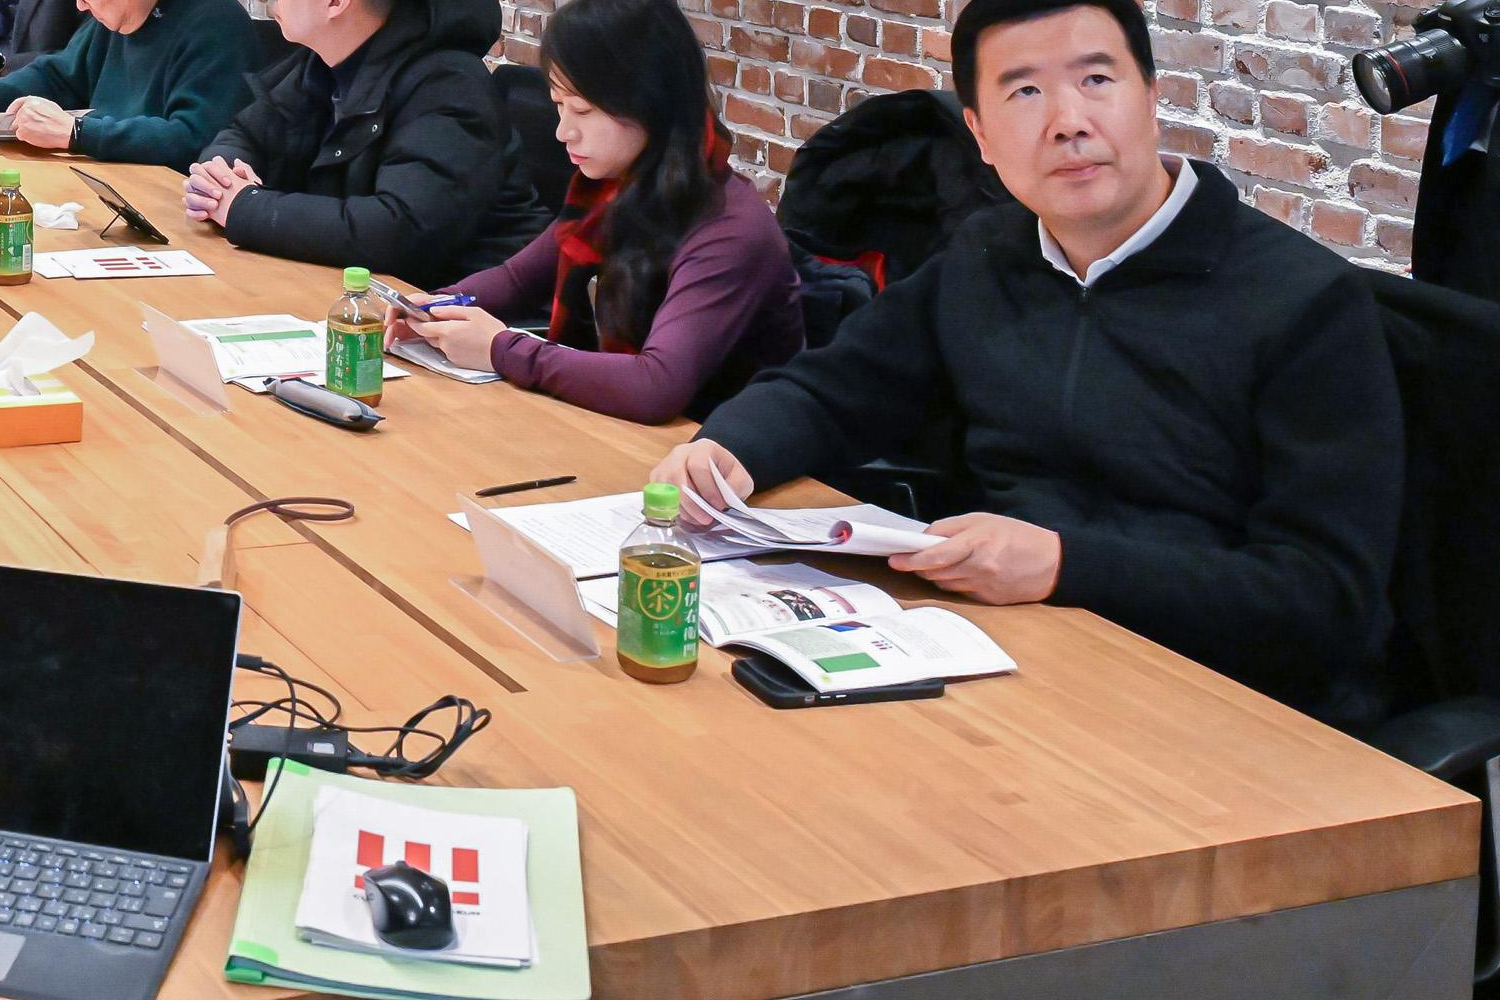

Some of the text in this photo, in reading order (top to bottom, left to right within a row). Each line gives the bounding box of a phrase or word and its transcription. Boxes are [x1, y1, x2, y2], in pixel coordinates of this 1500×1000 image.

[646, 581, 676, 613] 茶
[683, 592, 698, 657] 伊右衛門
